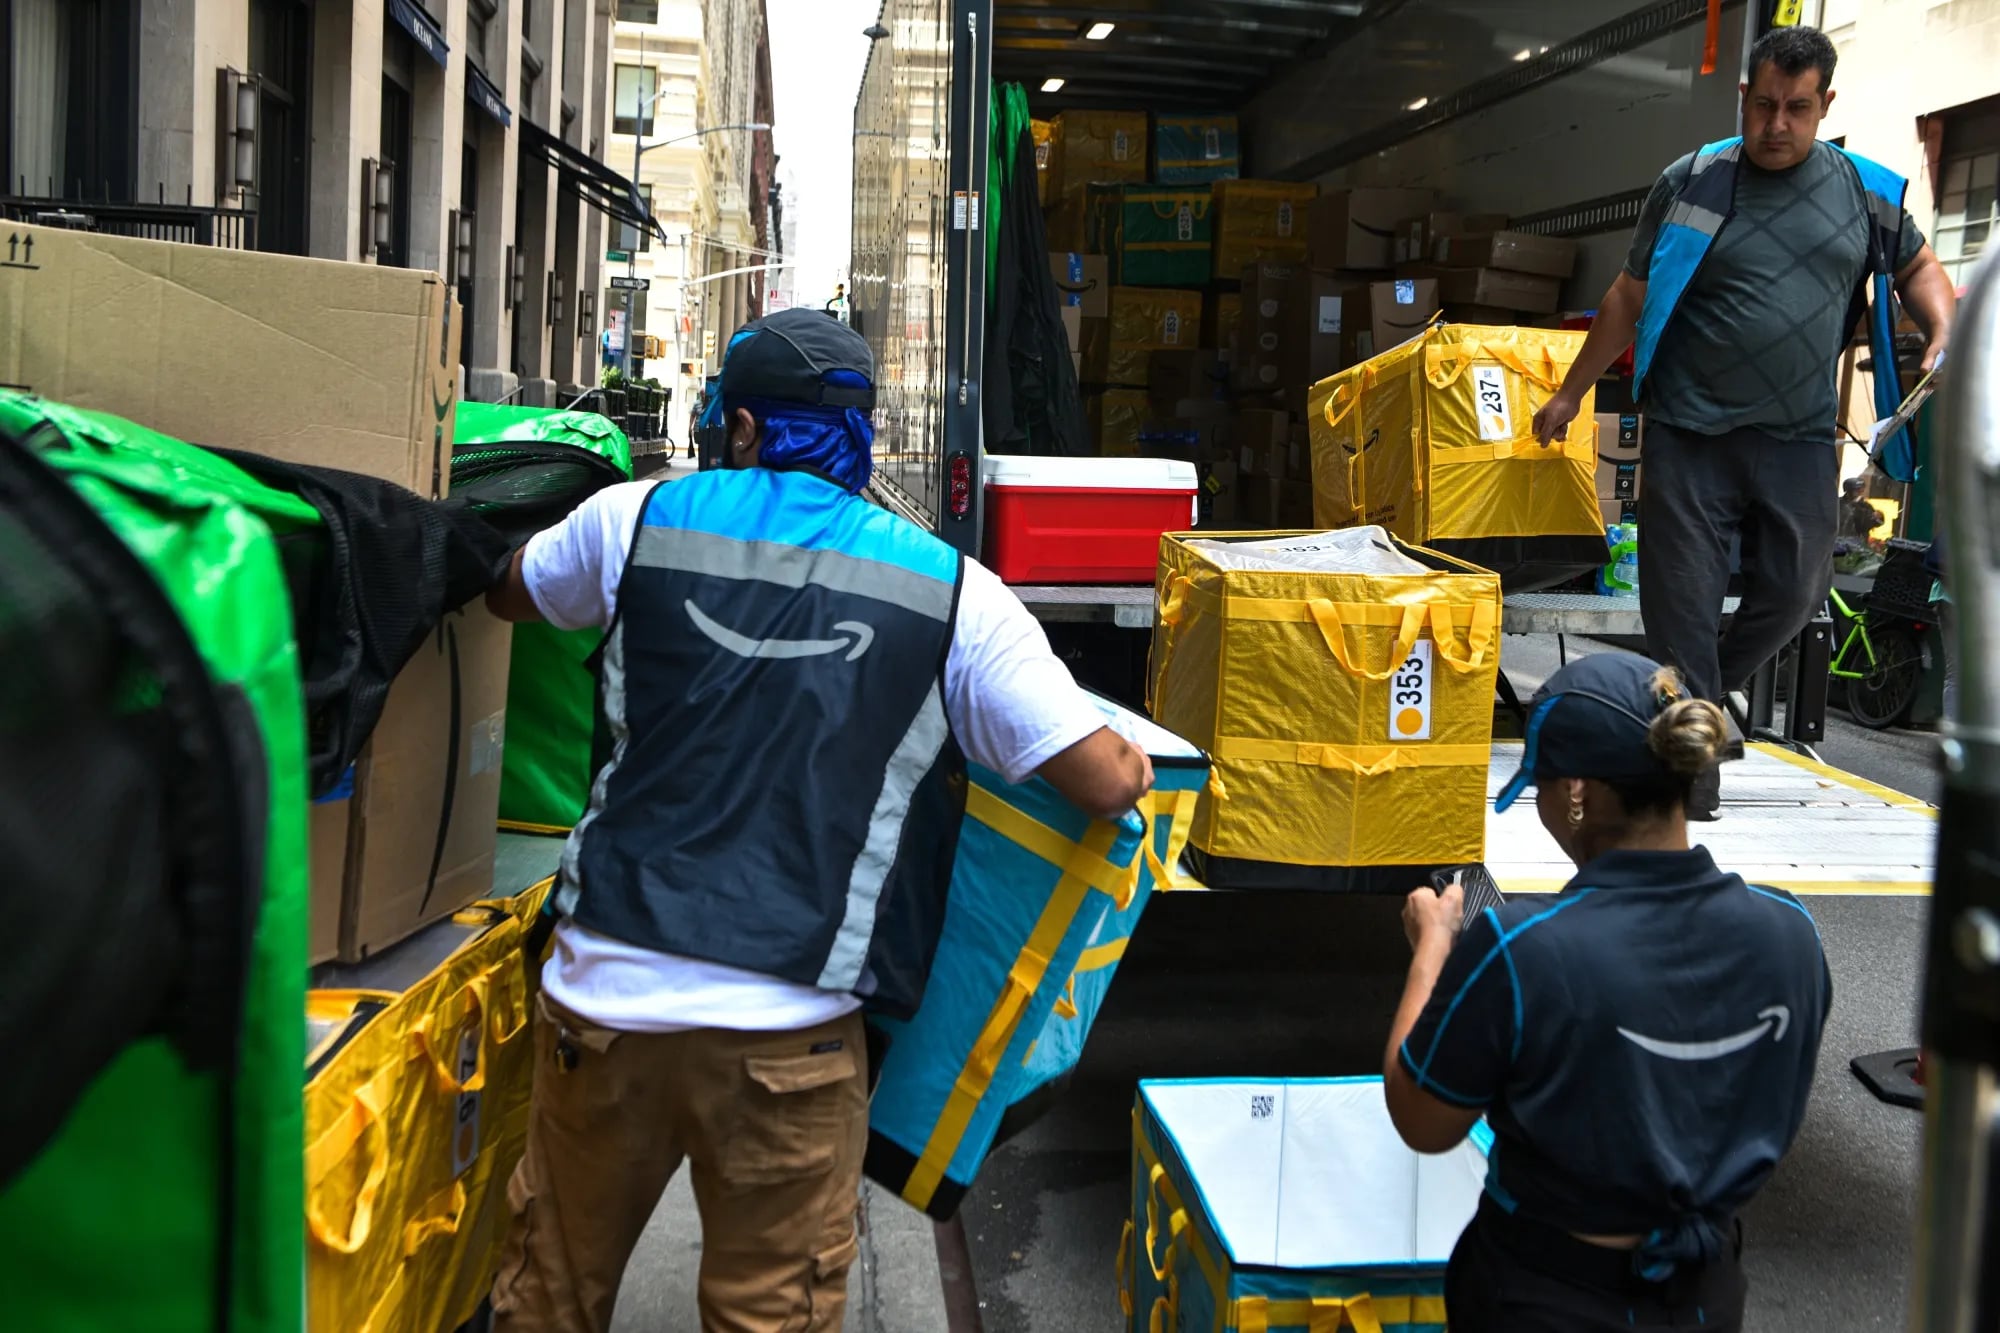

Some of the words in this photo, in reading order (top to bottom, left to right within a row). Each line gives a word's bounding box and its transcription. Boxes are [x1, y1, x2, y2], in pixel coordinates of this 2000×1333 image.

[413, 18, 433, 51] OCEANS
[1479, 379, 1503, 413] 237
[1396, 658, 1424, 705] 353
